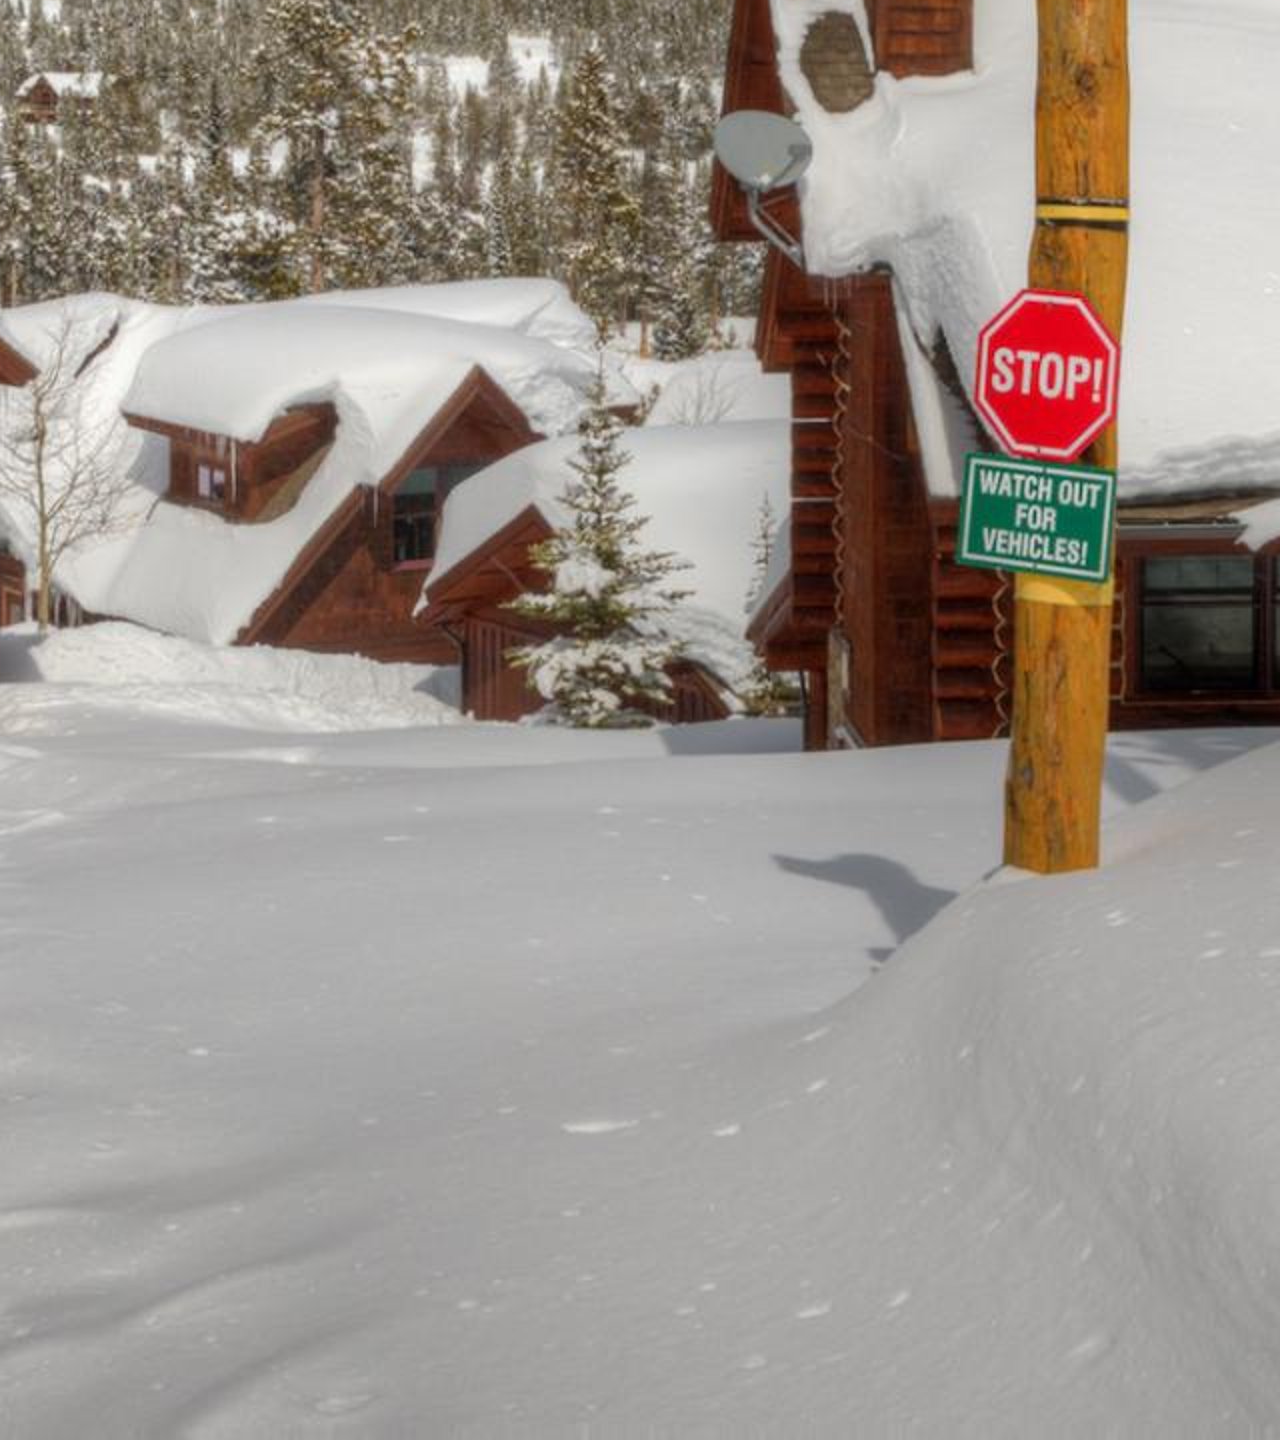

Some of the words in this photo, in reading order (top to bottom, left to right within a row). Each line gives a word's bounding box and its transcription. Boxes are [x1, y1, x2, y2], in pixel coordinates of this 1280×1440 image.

[991, 347, 1102, 403] STOP!
[979, 469, 1052, 502] WATCH
[1059, 483, 1101, 508] OUT
[1016, 503, 1056, 531] FOR
[982, 528, 1087, 565] VEHICLES!
